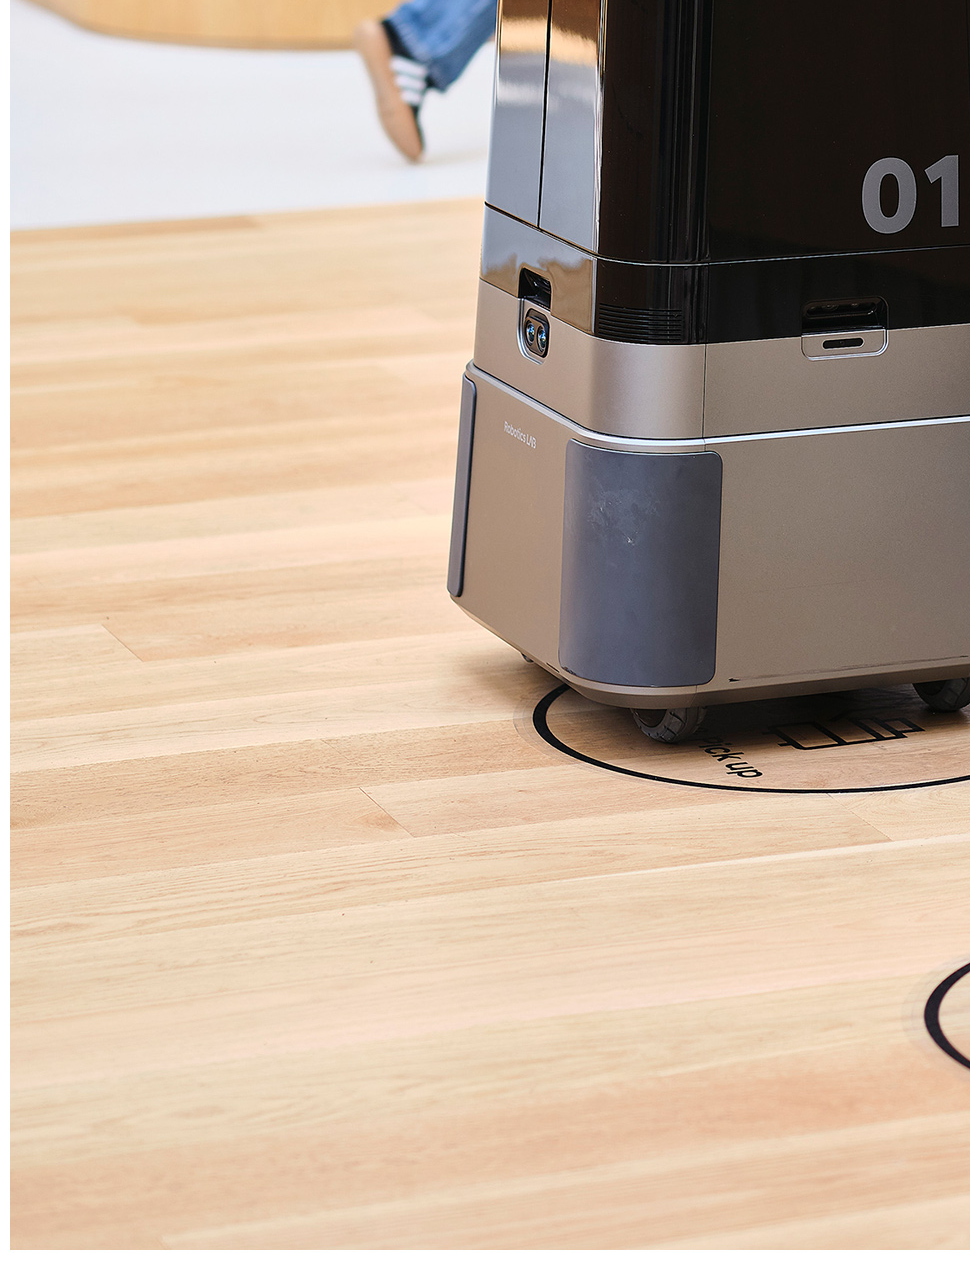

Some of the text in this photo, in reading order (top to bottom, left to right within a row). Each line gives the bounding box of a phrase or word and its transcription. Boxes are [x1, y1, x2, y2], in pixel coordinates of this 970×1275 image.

[862, 155, 959, 234] 01
[504, 421, 537, 449] Robotics LAB
[726, 762, 763, 778] up
